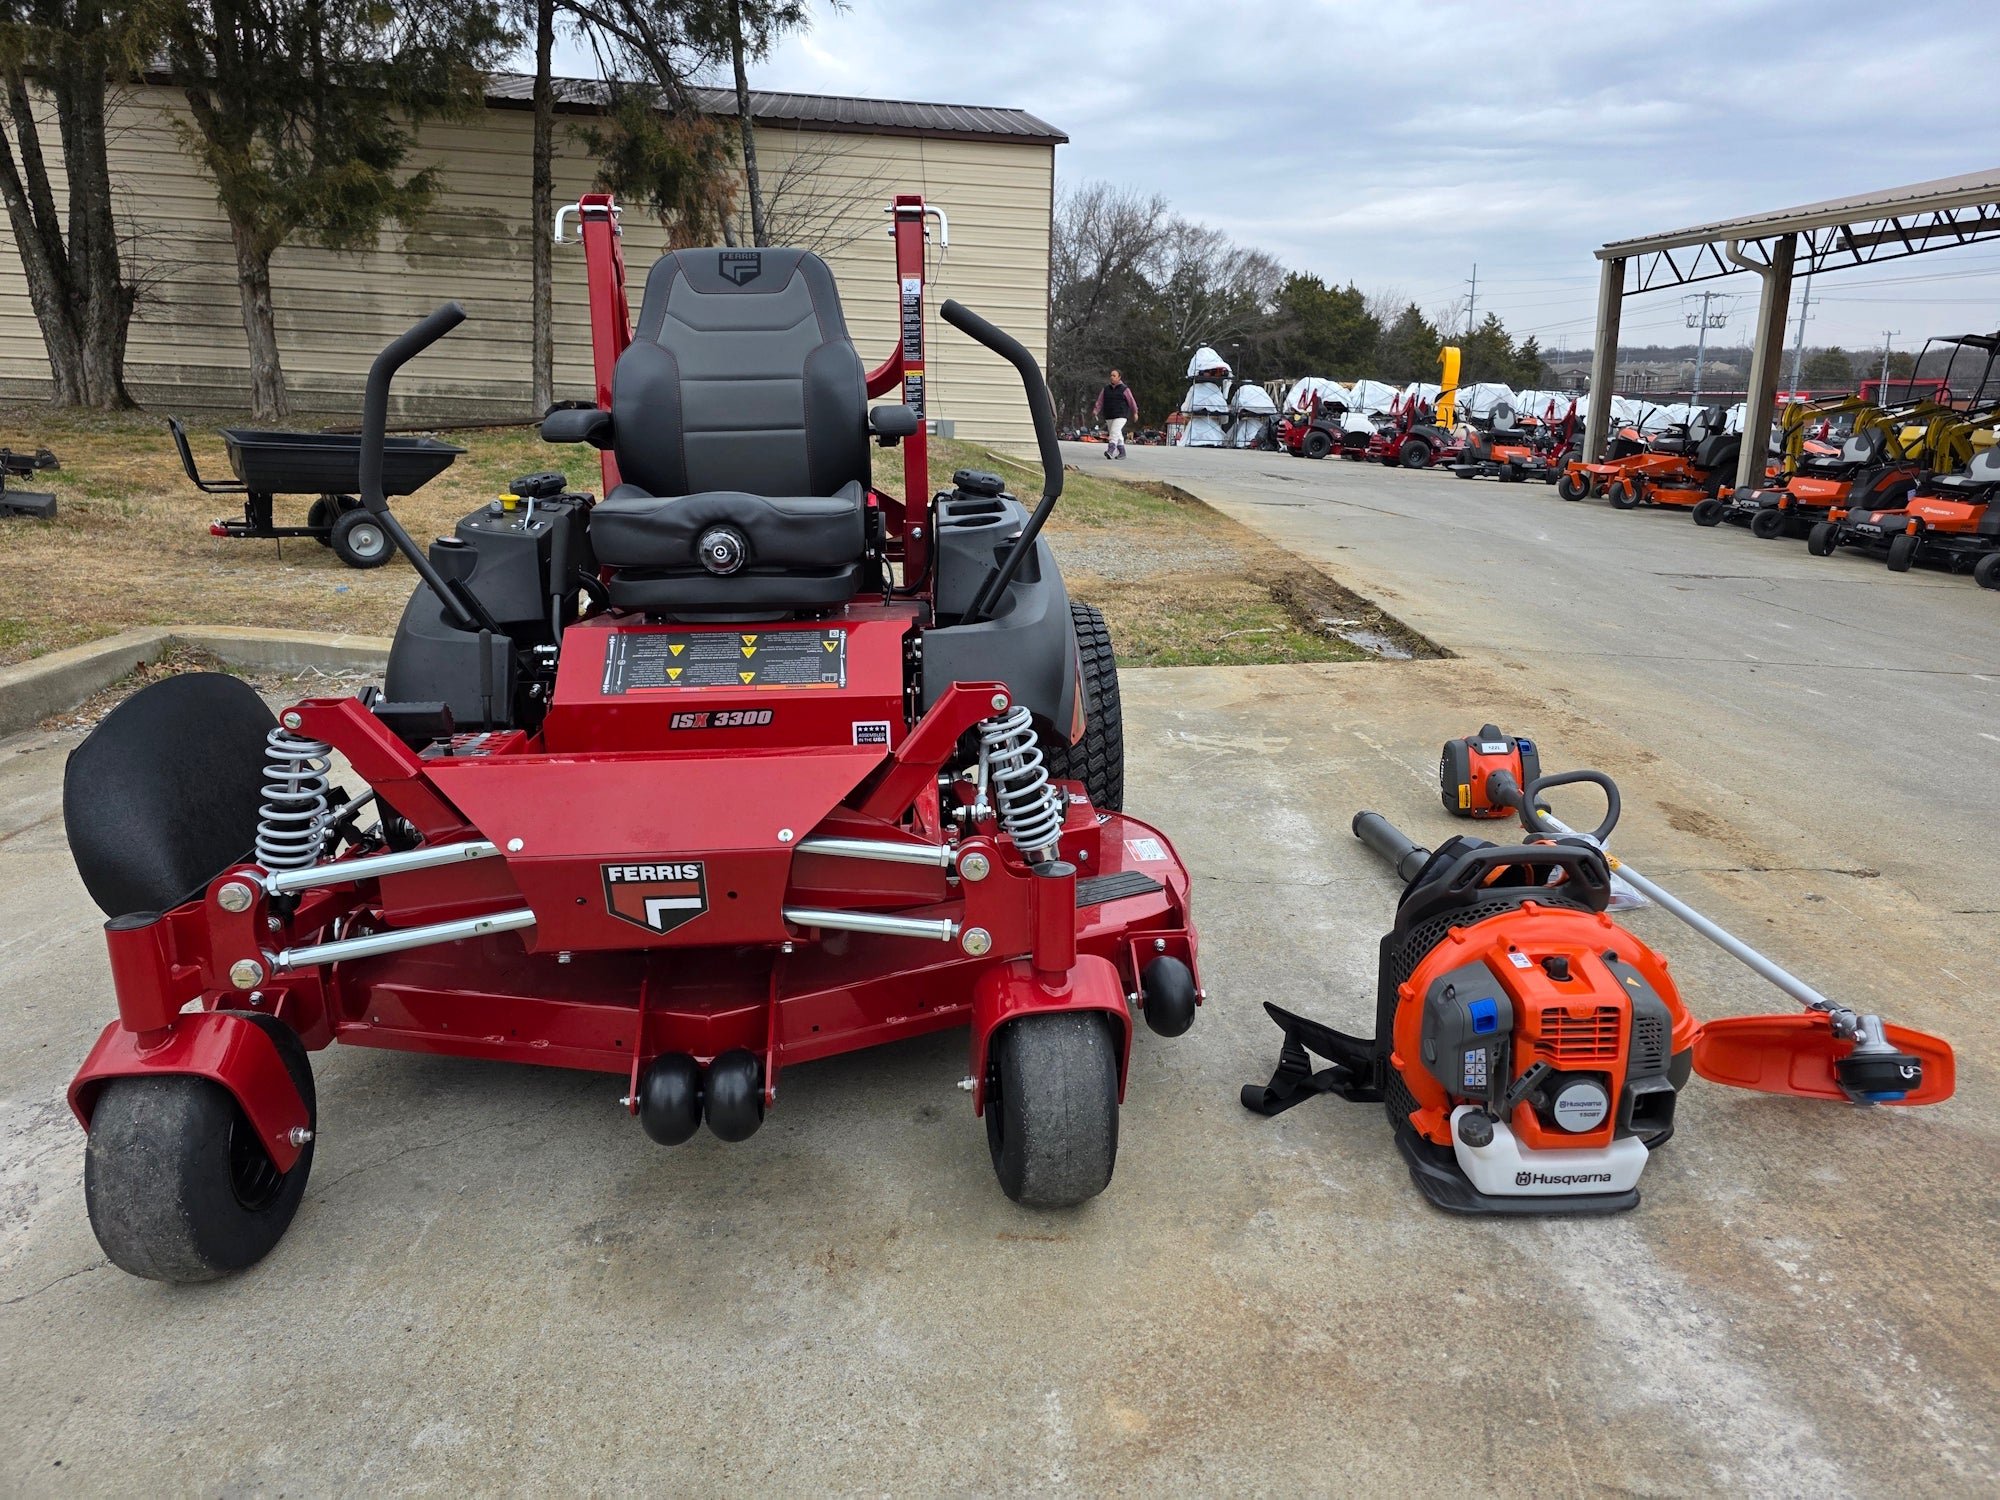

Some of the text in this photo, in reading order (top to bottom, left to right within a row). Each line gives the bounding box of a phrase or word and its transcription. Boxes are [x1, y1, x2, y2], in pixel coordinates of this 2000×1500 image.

[671, 710, 773, 729] ISX 3300
[608, 864, 700, 882] FERRIS
[1532, 1173, 1612, 1185] Husqvarna
